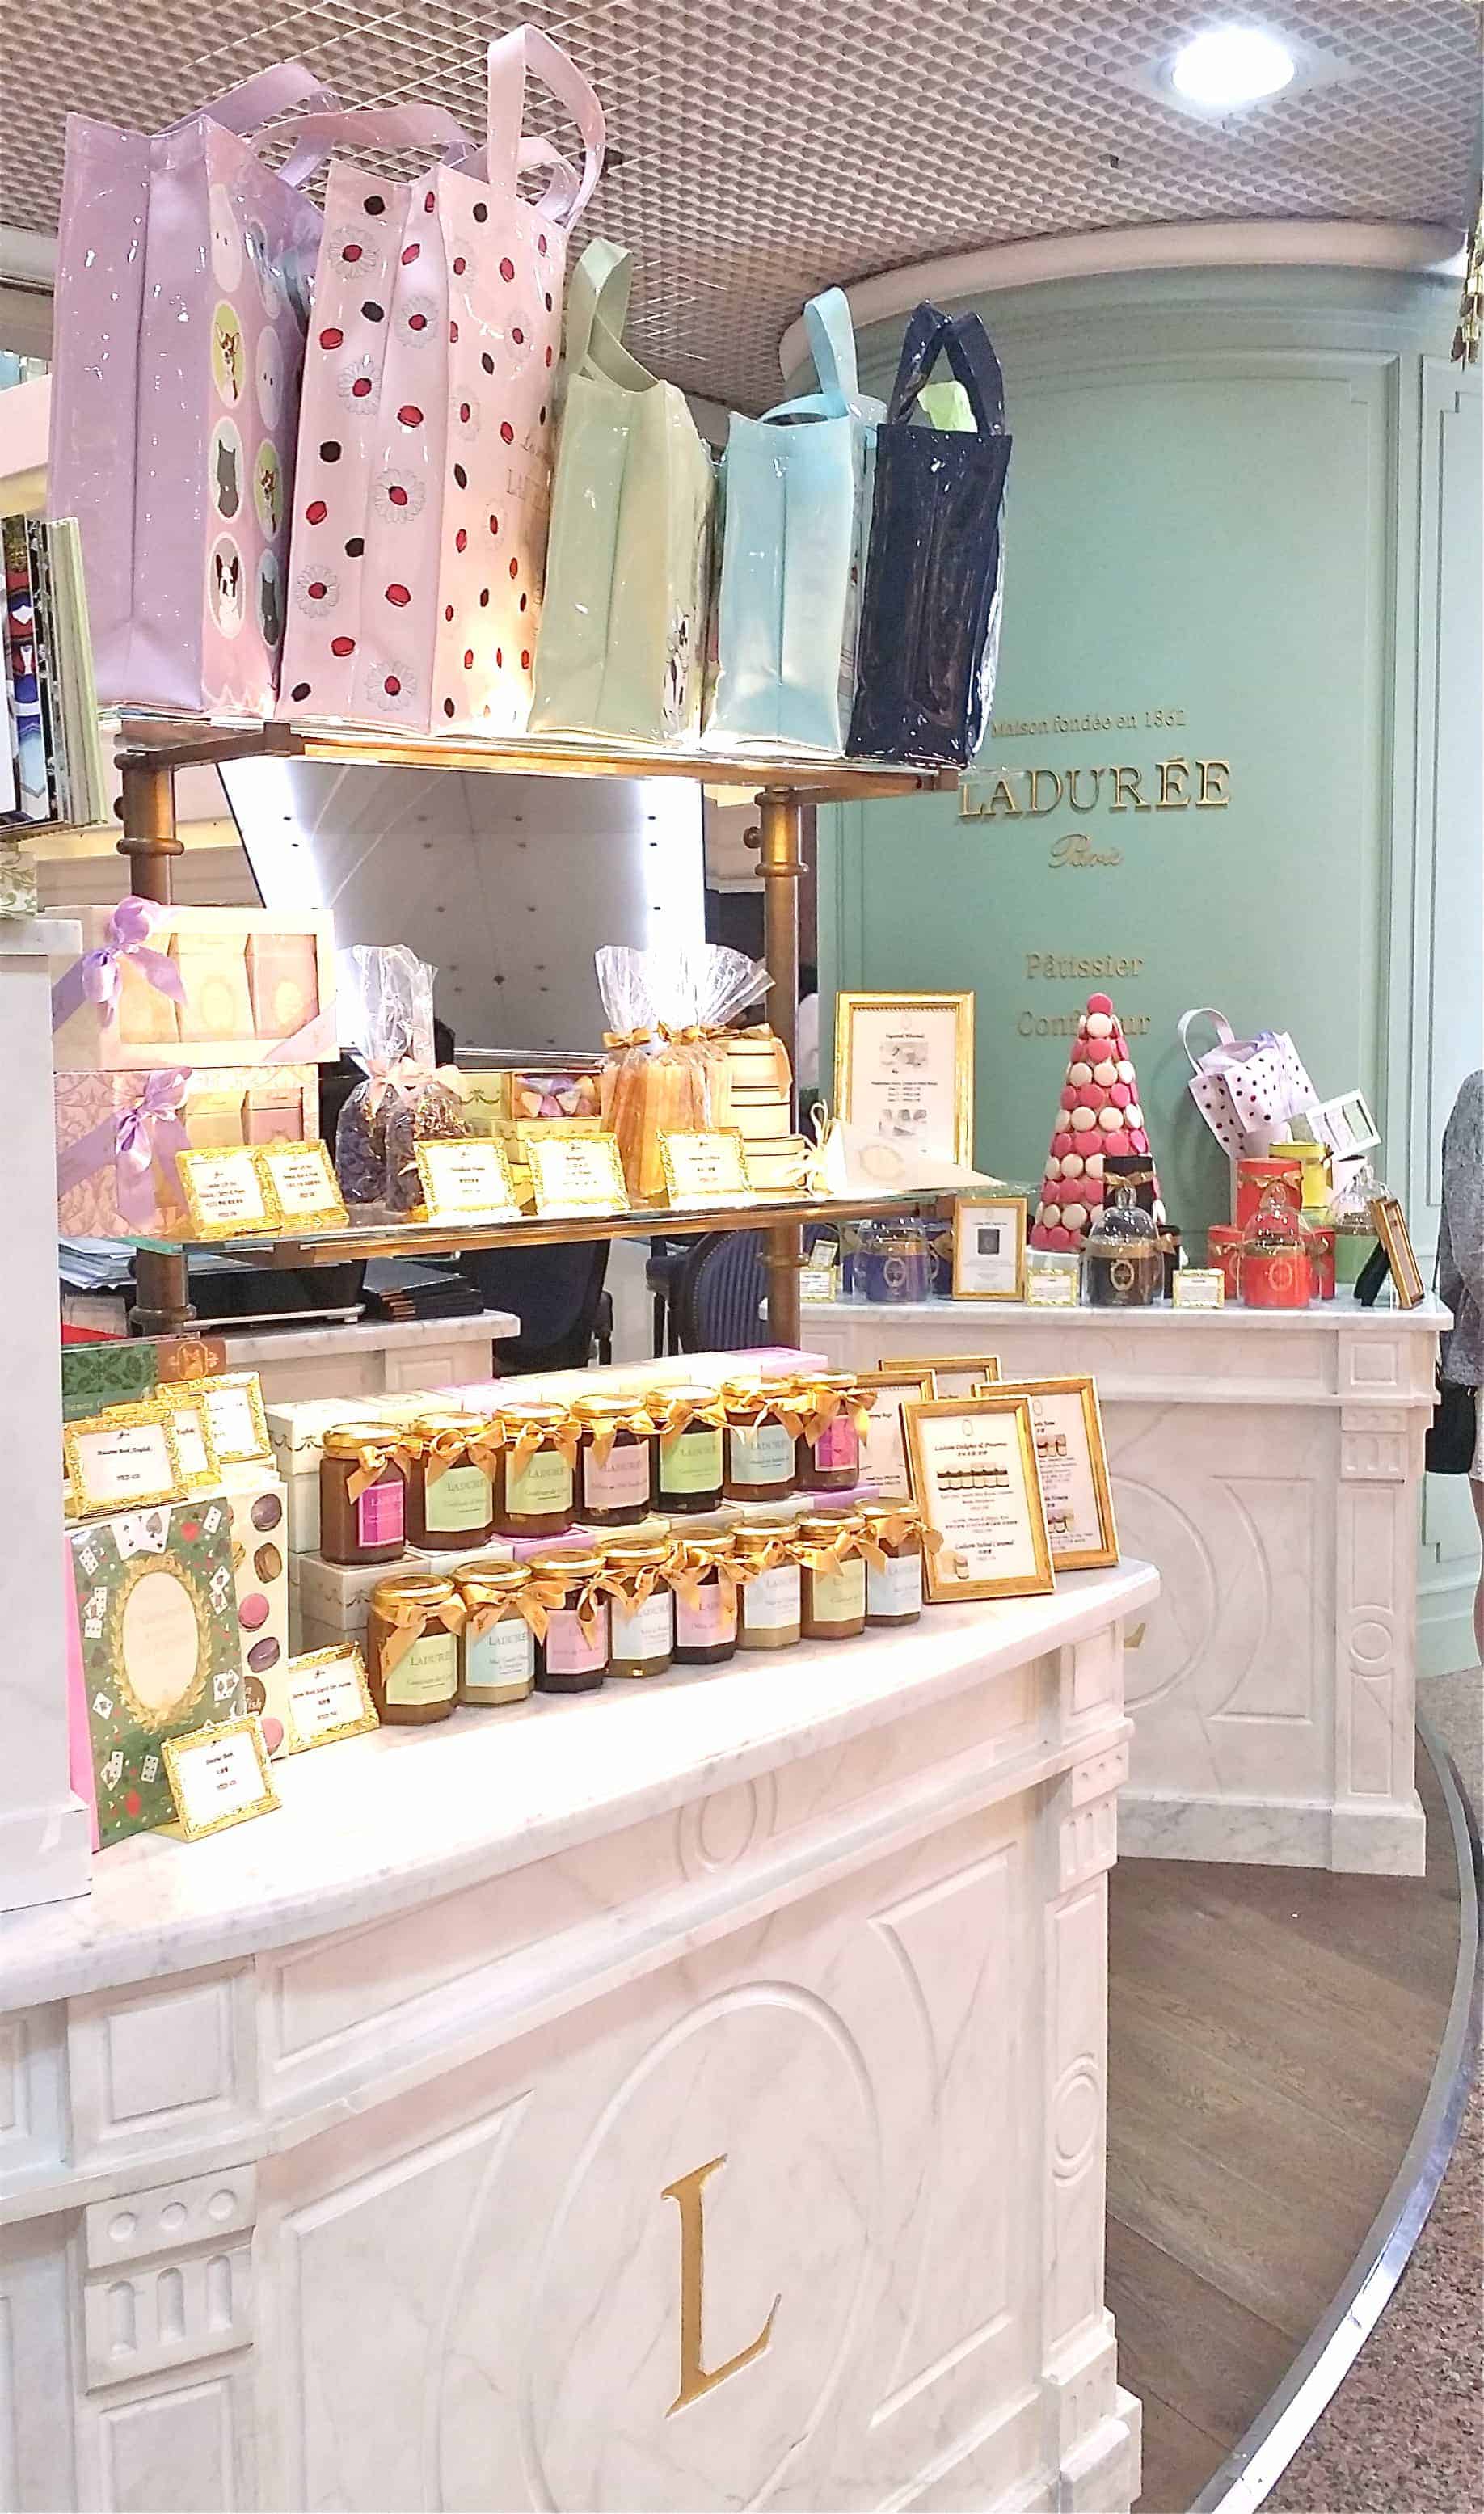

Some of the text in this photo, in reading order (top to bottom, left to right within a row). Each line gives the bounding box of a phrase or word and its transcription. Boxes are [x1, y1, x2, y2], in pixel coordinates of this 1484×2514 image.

[991, 708, 1187, 737] Maison fondée en 1862
[958, 756, 1231, 819] LADURÉE
[1048, 833, 1123, 868] Paris
[1026, 951, 1145, 980] Pâtissier
[1018, 1010, 1152, 1037] Confur
[660, 2153, 782, 2419] L
